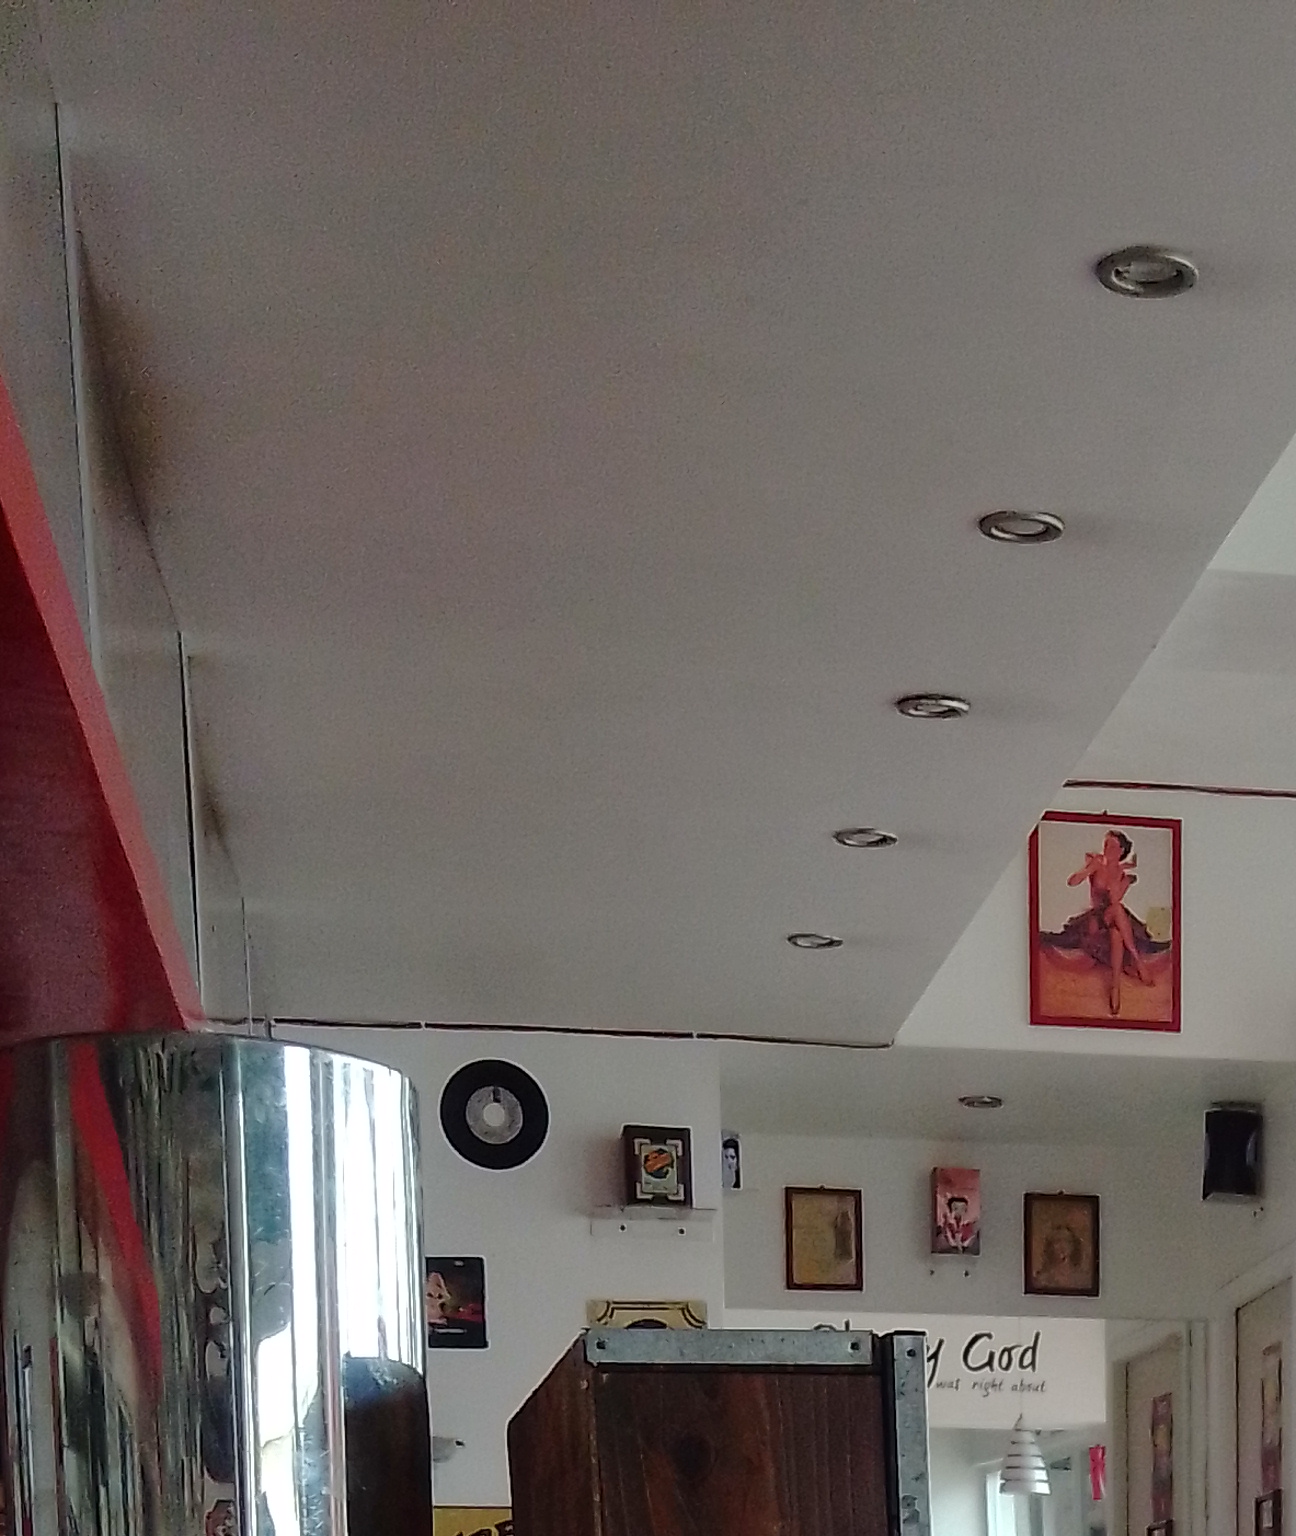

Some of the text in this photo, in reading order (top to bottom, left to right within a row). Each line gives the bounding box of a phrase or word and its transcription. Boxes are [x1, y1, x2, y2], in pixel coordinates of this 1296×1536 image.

[962, 1330, 1042, 1373] God
[971, 1379, 1005, 1398] right
[1010, 1378, 1047, 1393] about
